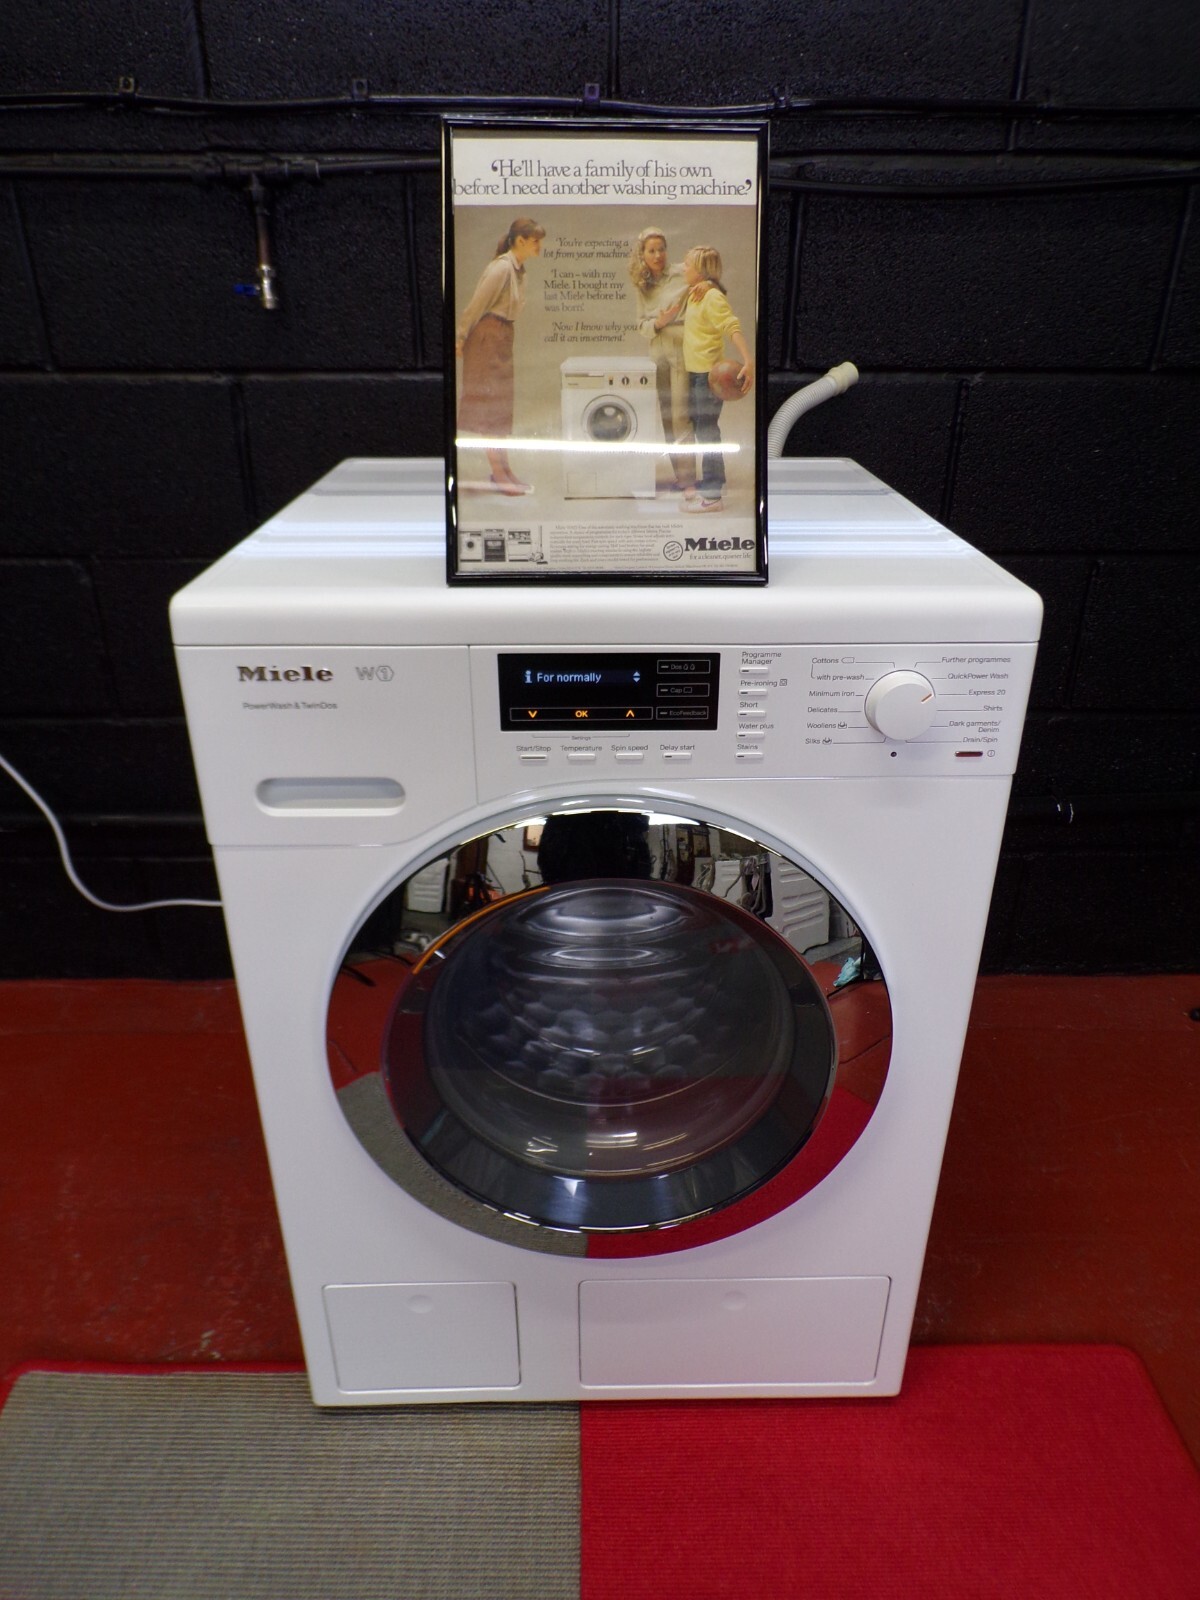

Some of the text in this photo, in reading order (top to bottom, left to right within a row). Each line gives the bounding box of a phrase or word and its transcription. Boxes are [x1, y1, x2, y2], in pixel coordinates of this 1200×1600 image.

[538, 160, 571, 177] have
[573, 167, 582, 177] a
[585, 159, 633, 182] family
[635, 159, 653, 178] of
[654, 160, 677, 177] his
[679, 166, 712, 178] own
[453, 178, 499, 195] before
[503, 178, 509, 195] I
[512, 178, 549, 195] need
[552, 178, 610, 195] another
[612, 178, 677, 200] washing
[584, 238, 622, 249] expecting
[543, 249, 554, 258] lot
[554, 249, 574, 260] from
[576, 252, 594, 260] your
[582, 269, 600, 278] with
[602, 271, 616, 280] my
[572, 280, 576, 289] I
[578, 280, 608, 291] bought
[610, 282, 624, 290] my
[544, 291, 626, 300] last Miele before he
[574, 322, 579, 331] I
[580, 322, 603, 331] know
[605, 321, 621, 332] why
[622, 325, 638, 334] you
[544, 333, 558, 342] call
[559, 333, 565, 342] it
[684, 537, 756, 551] Miele
[741, 651, 782, 659] Programme
[237, 666, 333, 682] Miele
[833, 674, 865, 682] pre-wash
[989, 672, 1009, 680] Wash
[537, 672, 554, 682] For
[556, 672, 602, 686] normally
[740, 680, 778, 688] Pre-ironing
[670, 686, 683, 695] Cap
[968, 689, 994, 697] Express
[575, 709, 589, 718] OK
[759, 723, 774, 731] plus
[962, 736, 998, 744] Drain/Spin
[611, 744, 648, 753] Spin speed
[659, 744, 677, 753] Delay
